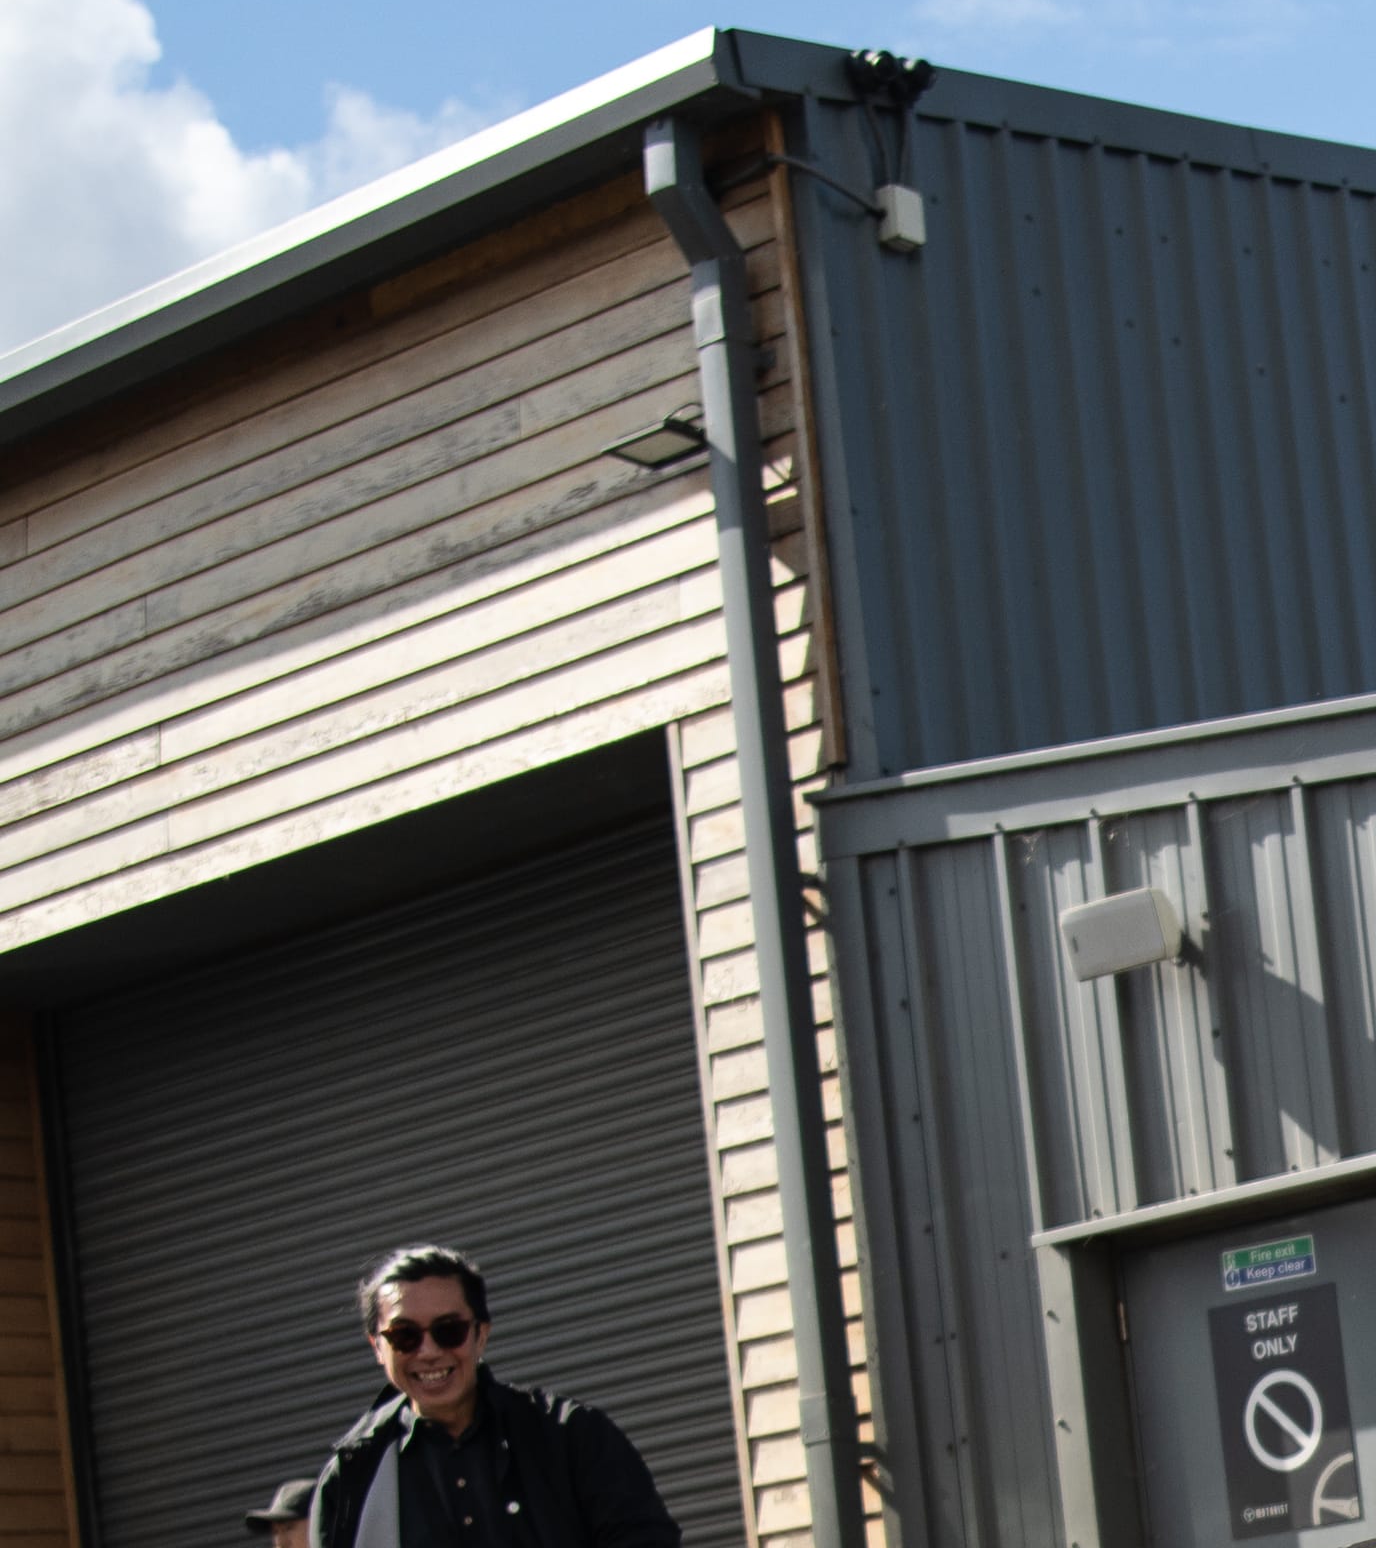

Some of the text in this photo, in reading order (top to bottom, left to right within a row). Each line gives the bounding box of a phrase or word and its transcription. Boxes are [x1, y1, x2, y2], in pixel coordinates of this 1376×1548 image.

[1250, 1243, 1296, 1263] Fire exit
[1246, 1260, 1306, 1279] Keep clear
[1245, 1304, 1298, 1333] STAFF
[1253, 1334, 1297, 1360] ONLY
